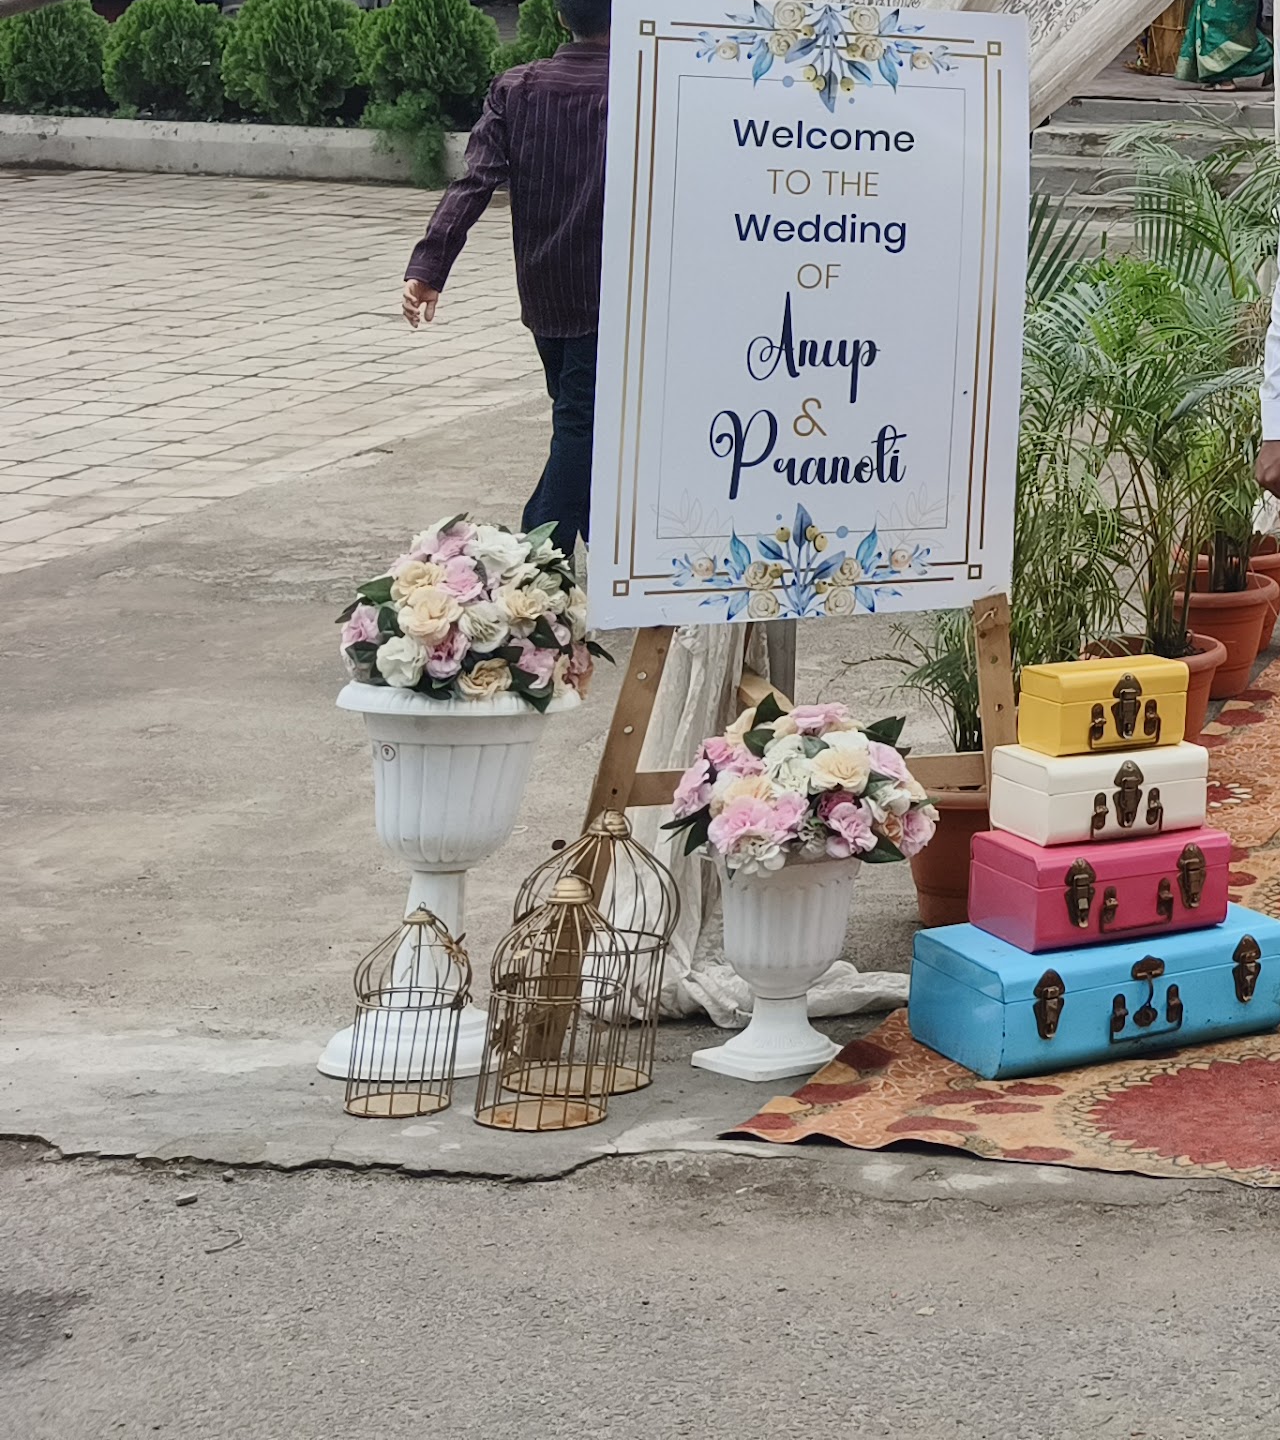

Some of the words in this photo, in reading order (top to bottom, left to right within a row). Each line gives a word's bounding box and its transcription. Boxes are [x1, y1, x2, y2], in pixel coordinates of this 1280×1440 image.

[733, 118, 915, 153] Welcome
[766, 168, 811, 195] TO
[822, 170, 880, 197] THE
[734, 213, 907, 253] Wedding
[796, 263, 841, 290] OF
[746, 291, 881, 403] Anup
[793, 398, 828, 437] &
[709, 409, 907, 500] Pranoti
